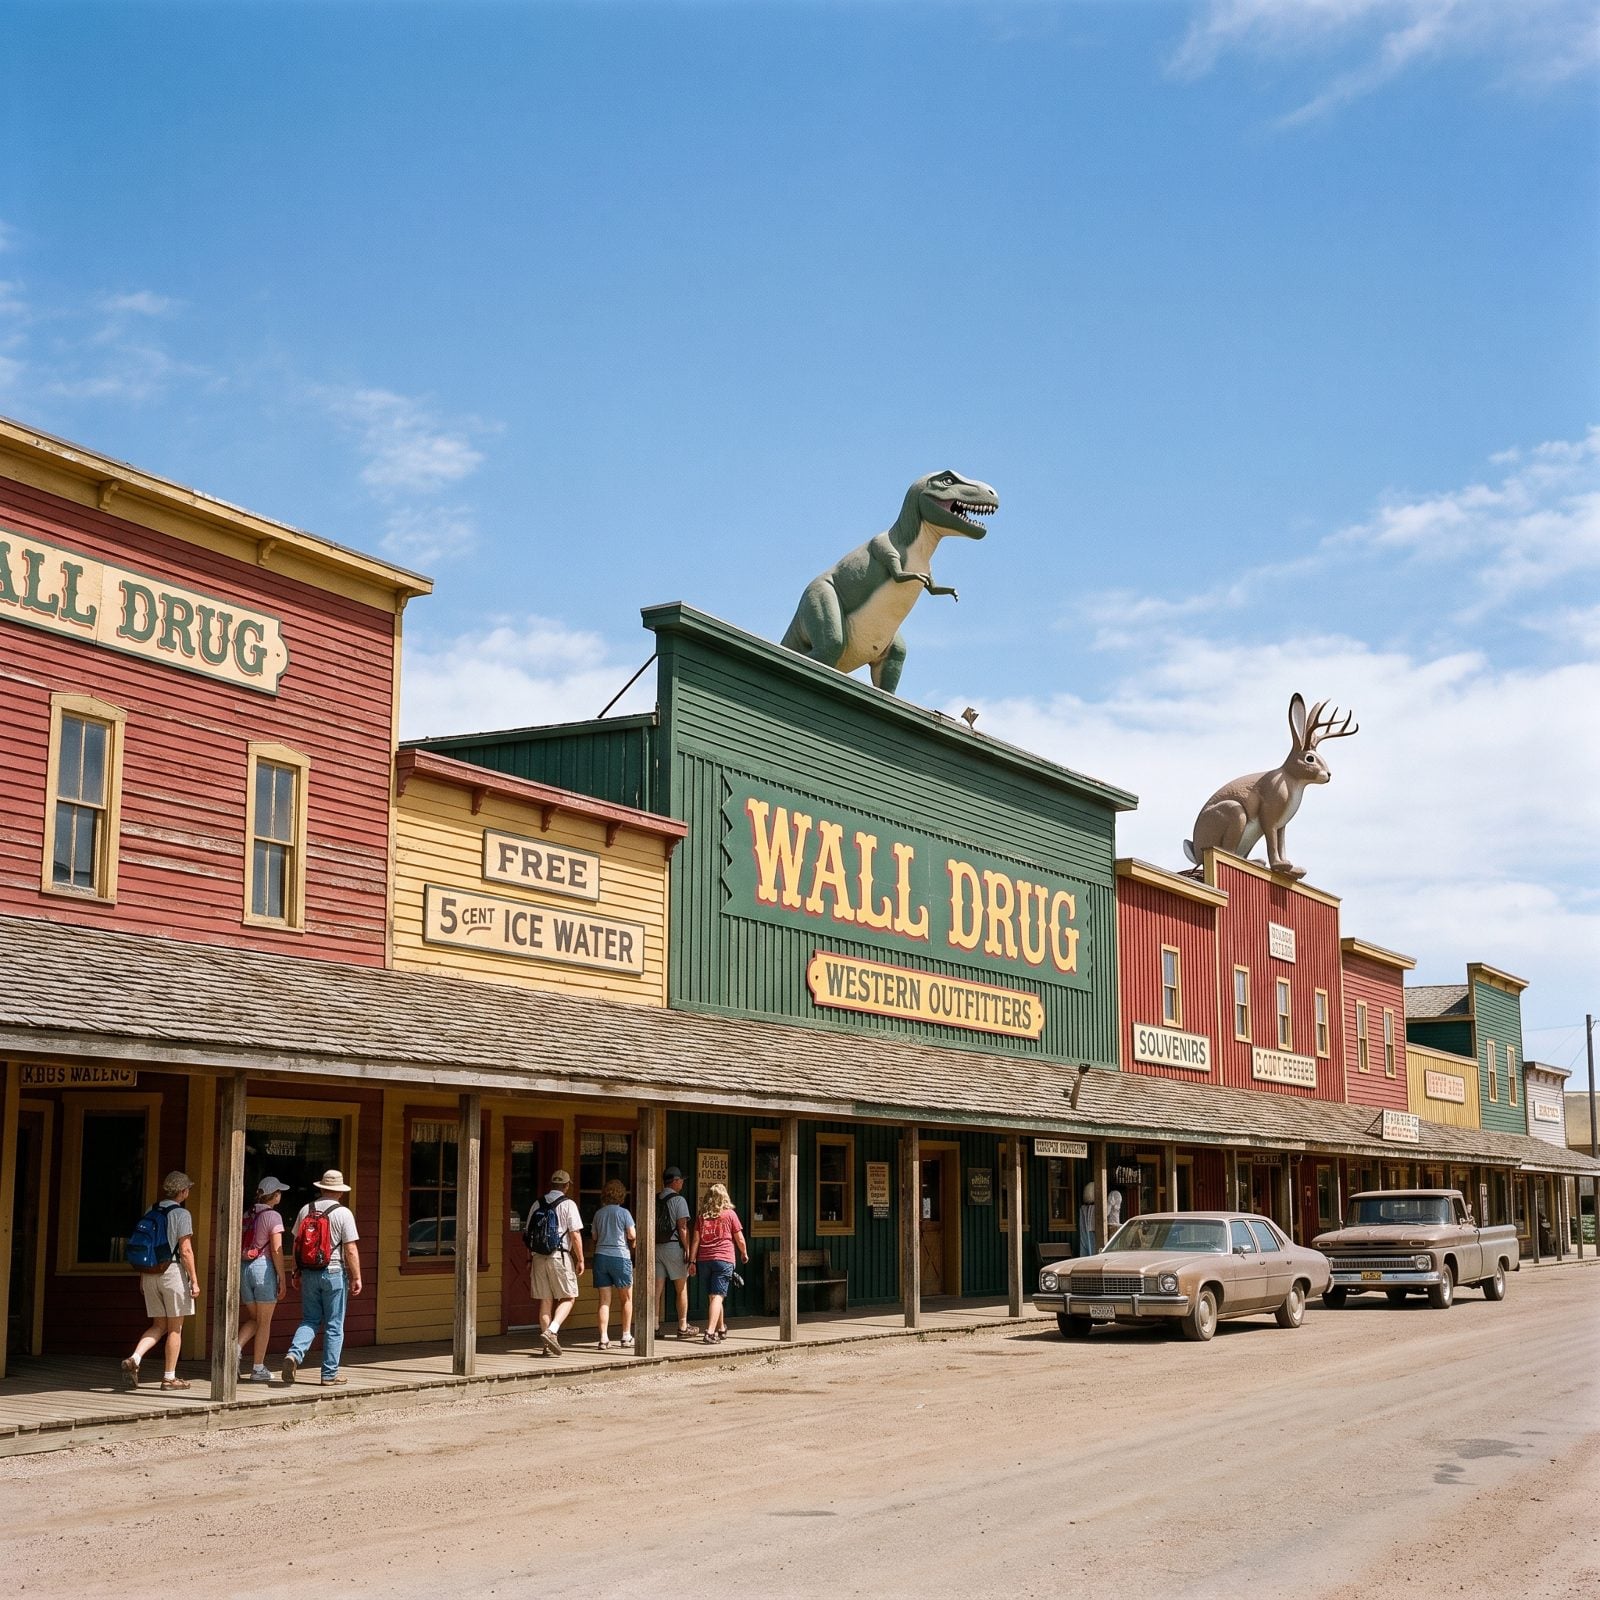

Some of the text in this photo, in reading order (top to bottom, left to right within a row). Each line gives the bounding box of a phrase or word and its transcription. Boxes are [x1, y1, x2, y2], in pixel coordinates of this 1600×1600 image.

[117, 580, 267, 676] DRUG
[497, 842, 588, 889] FREE
[745, 798, 1080, 973] WALL DRUG
[440, 897, 634, 964] 5 CENT ICE WATER
[825, 962, 1032, 1030] WESTERN OUTFITTERS
[1139, 1030, 1207, 1065] SOUVENIRS
